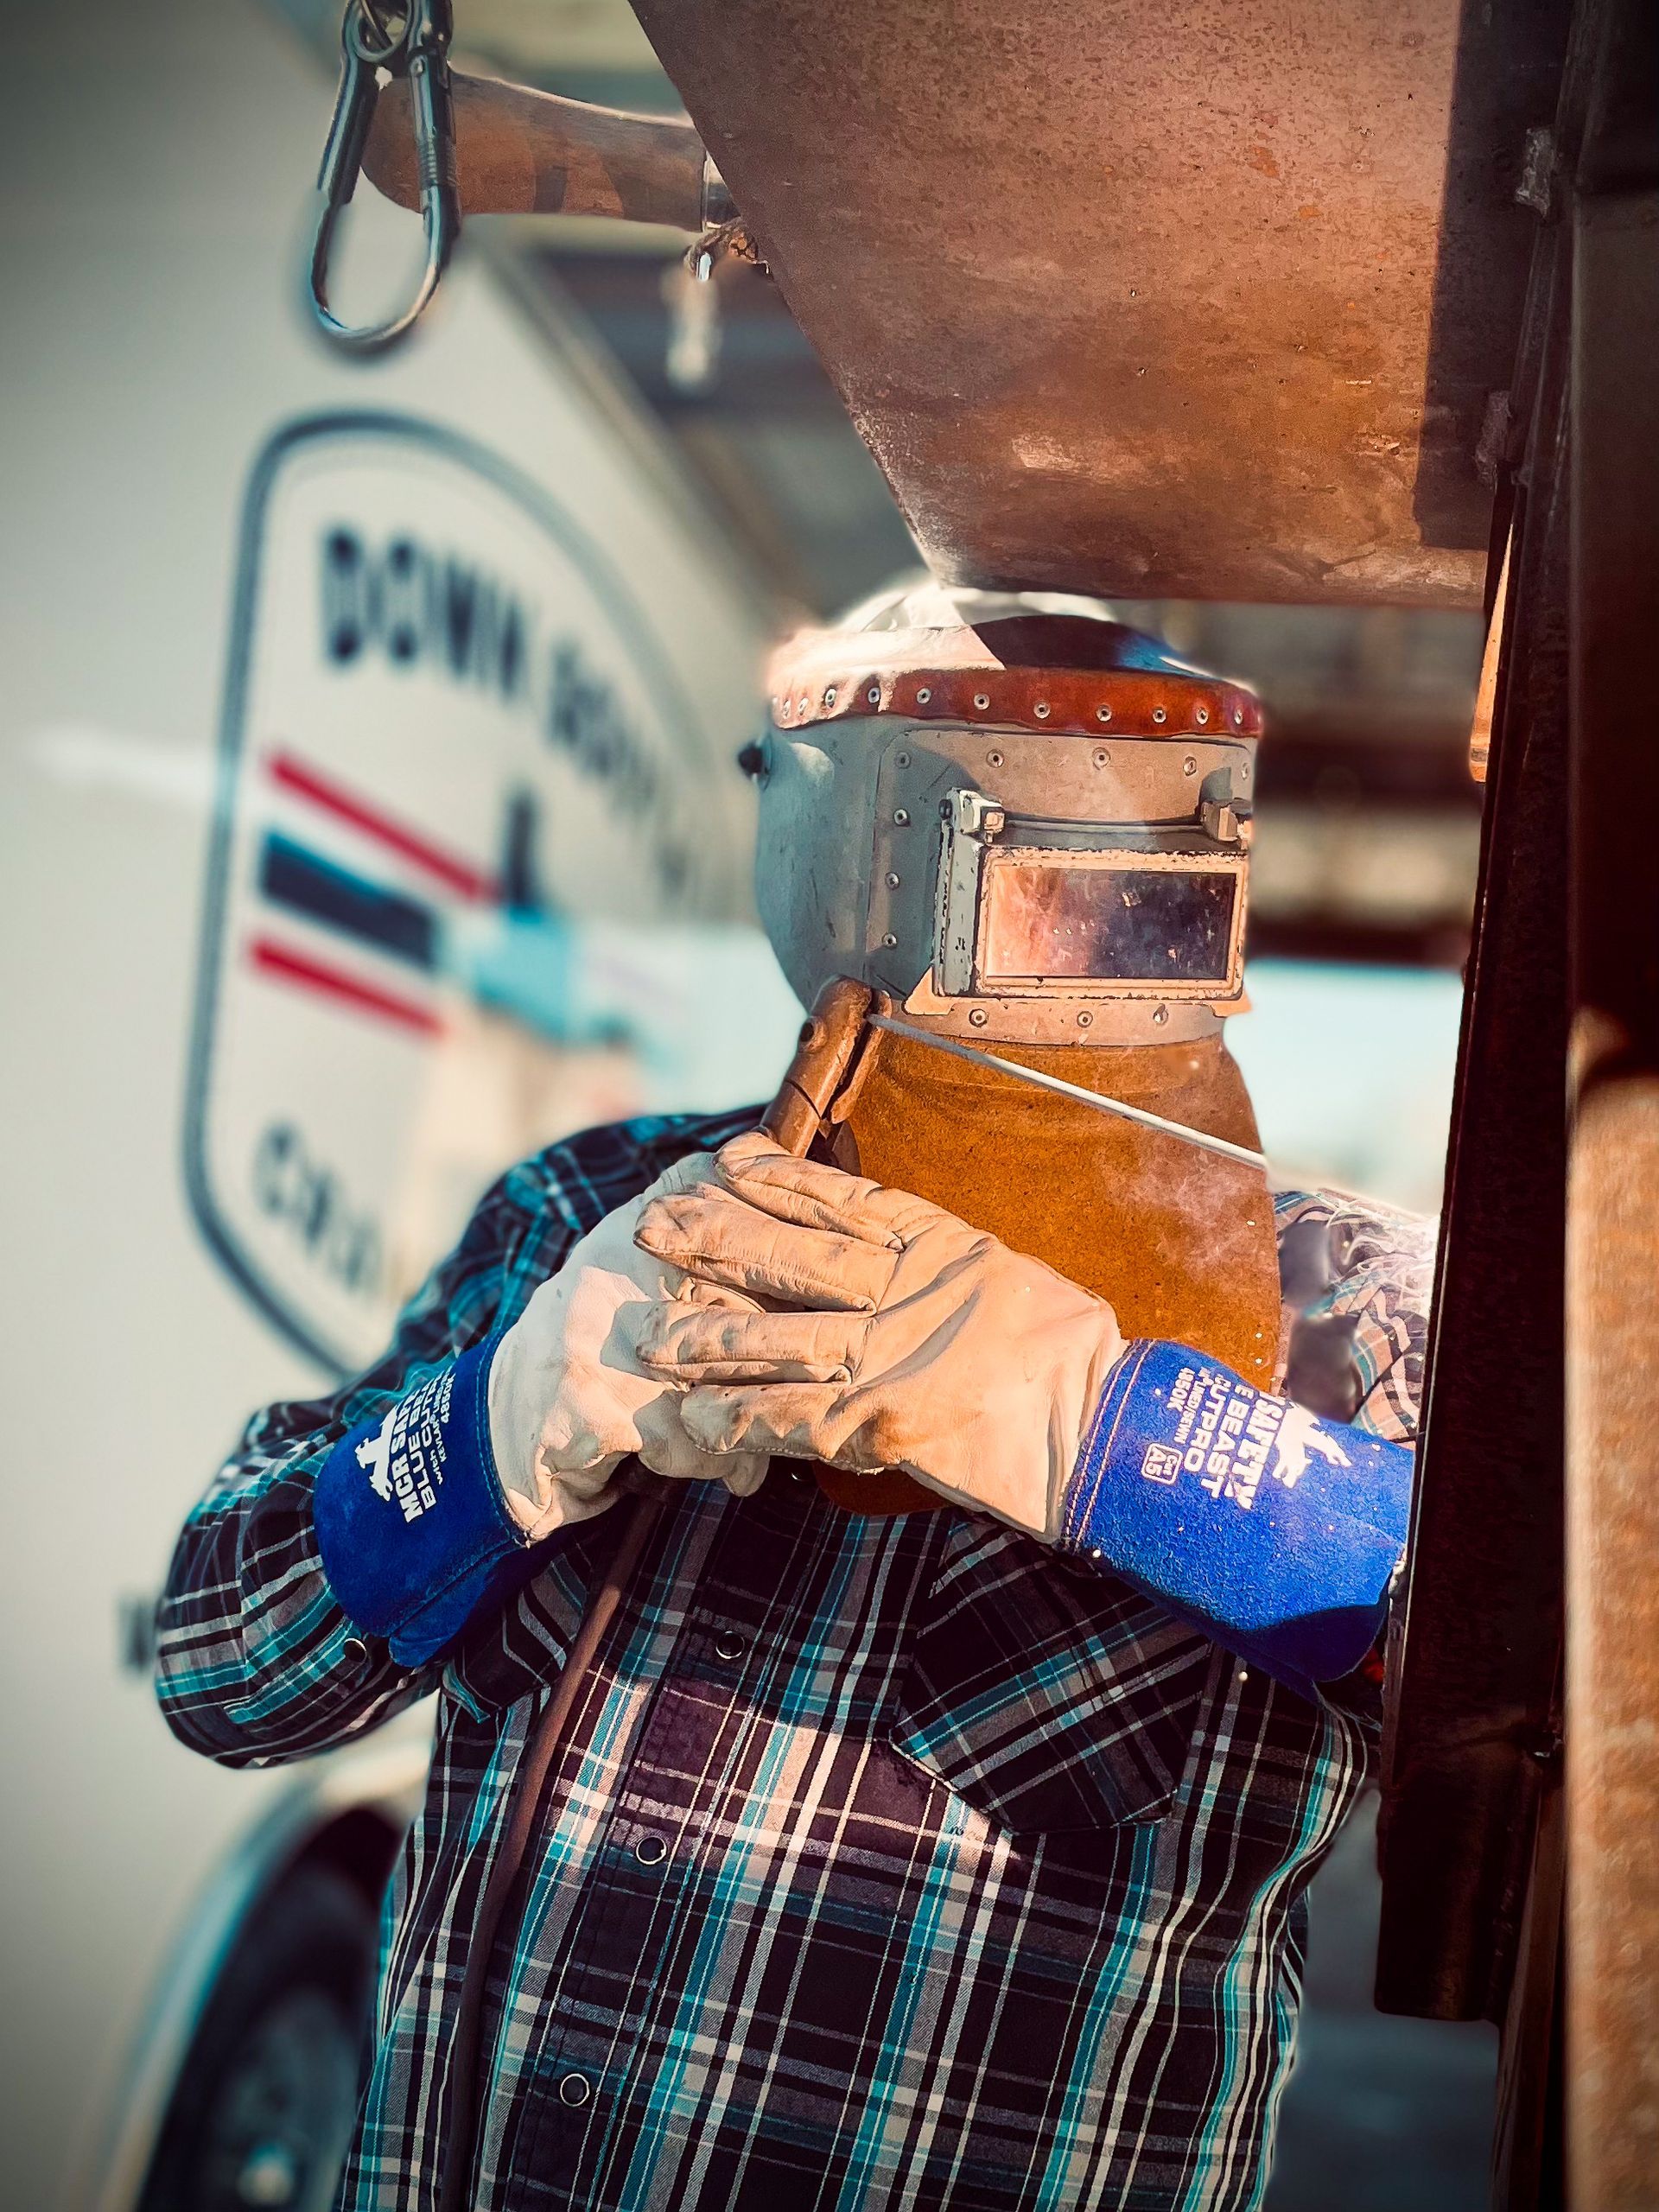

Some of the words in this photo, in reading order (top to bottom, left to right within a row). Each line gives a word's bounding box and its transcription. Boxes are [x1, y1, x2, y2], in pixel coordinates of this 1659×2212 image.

[409, 1382, 430, 1427] BEA
[391, 1452, 423, 1523] MCR
[408, 1431, 436, 1510] BLUE
[1200, 1398, 1250, 1499] BEAST
[1224, 1398, 1284, 1510] SAFETY
